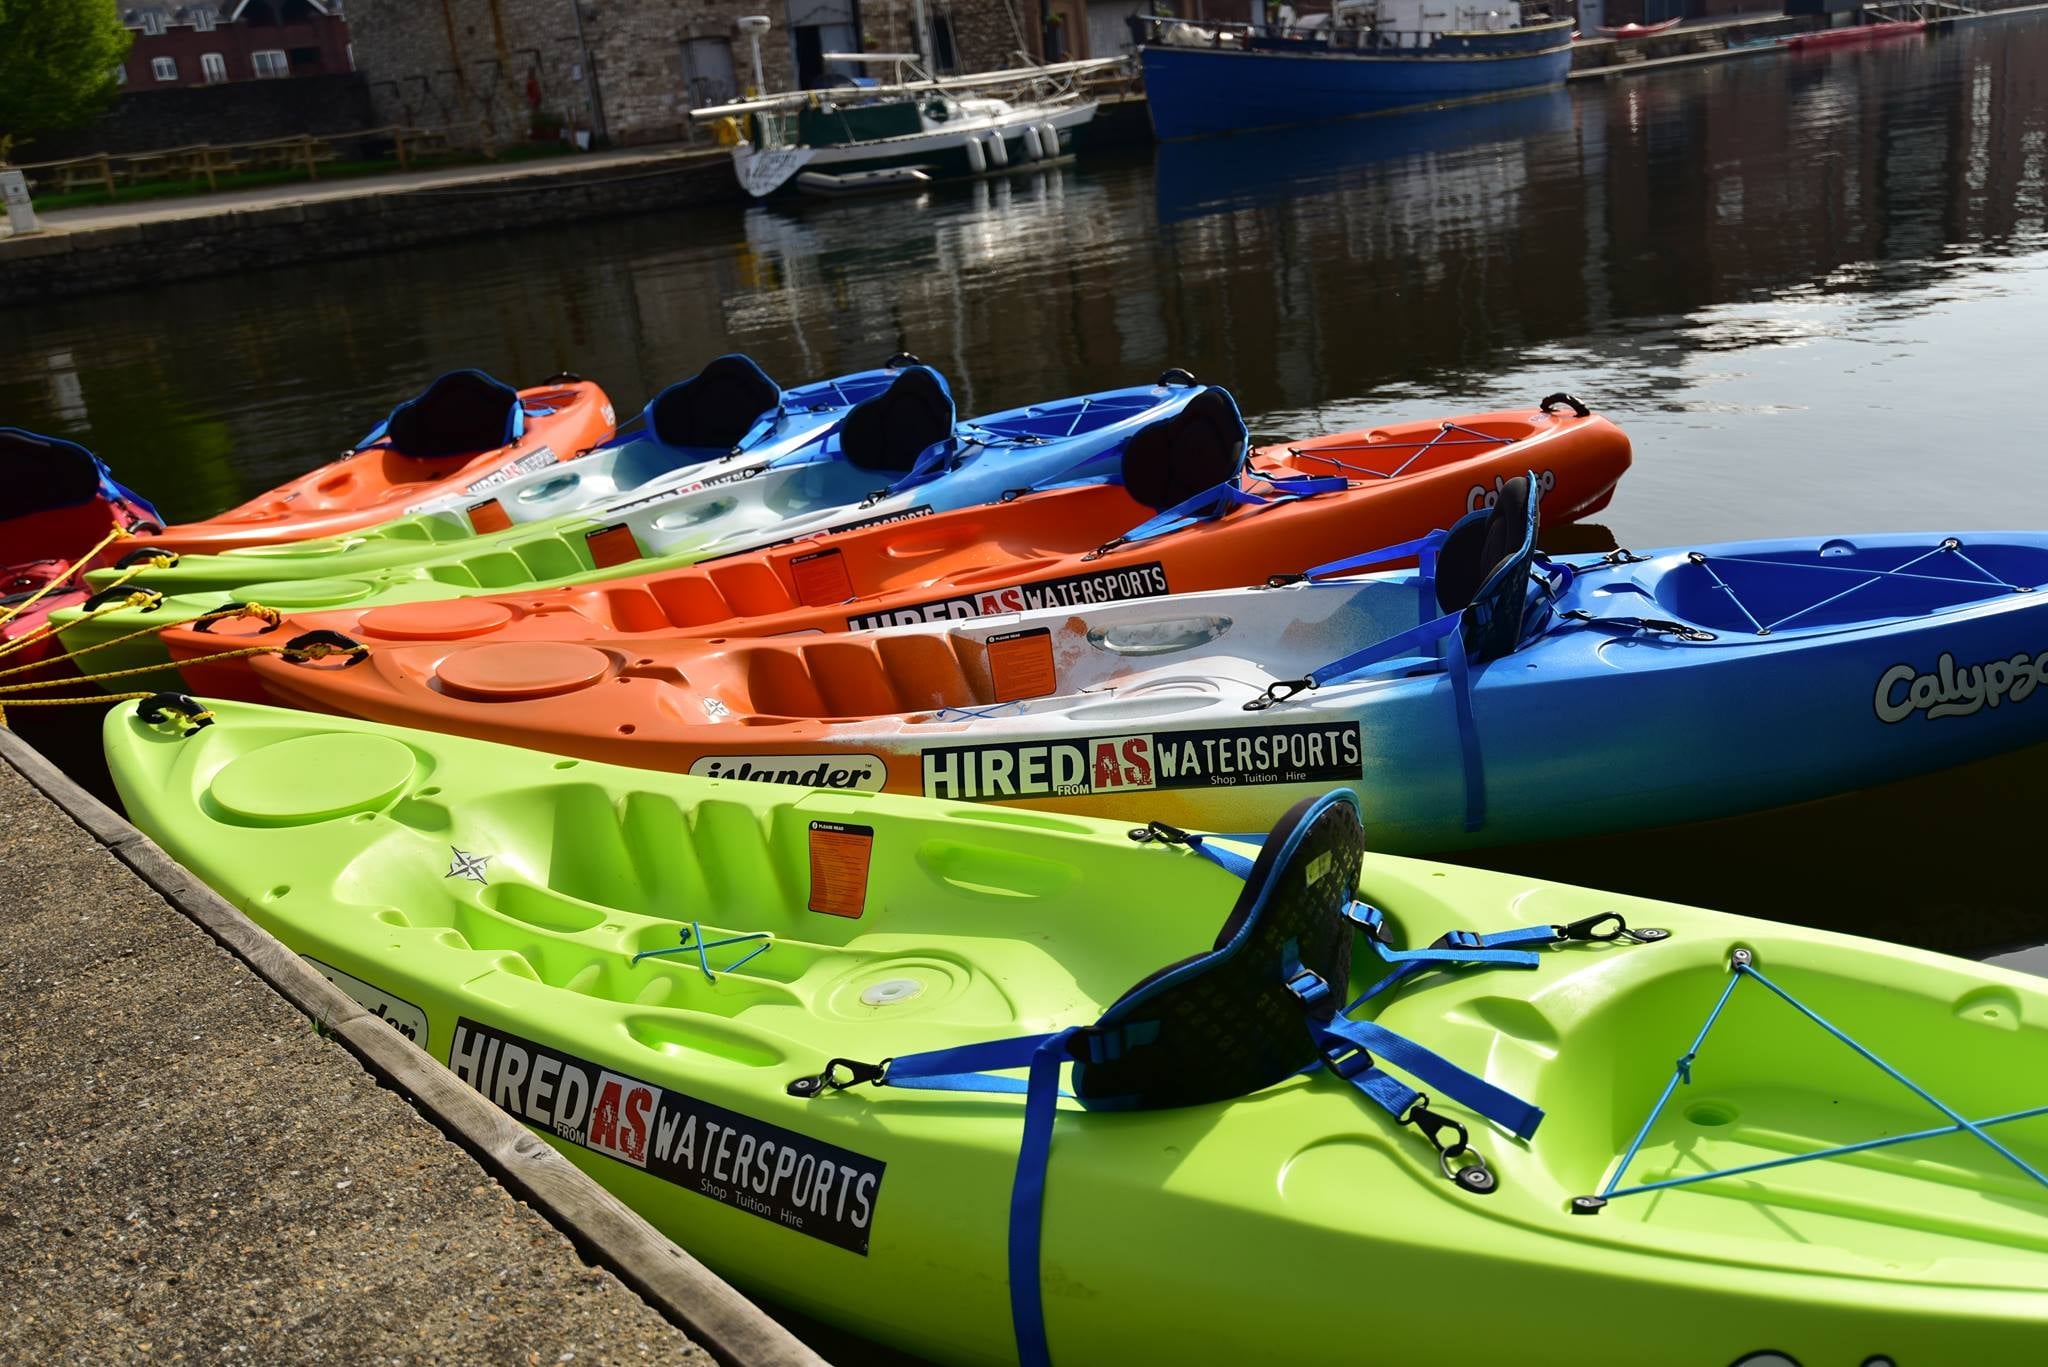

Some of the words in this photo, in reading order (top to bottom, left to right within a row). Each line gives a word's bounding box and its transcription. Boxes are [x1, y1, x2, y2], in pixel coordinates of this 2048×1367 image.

[1026, 566, 1166, 610] WATERSPORTS
[923, 745, 1085, 799] HIRED
[1057, 784, 1090, 796] FROM
[1093, 738, 1153, 788] AS
[1157, 729, 1359, 778] WATERSPORTS
[1211, 775, 1236, 786] Shop
[1243, 773, 1278, 784] Tuition
[1286, 771, 1307, 781] Hire
[450, 1026, 589, 1129] HIRED
[557, 1122, 586, 1145] FROM
[590, 1081, 652, 1163] AS
[655, 1105, 877, 1229] WATERSPORTS
[701, 1178, 728, 1200] Shop
[735, 1191, 771, 1217] Tuition
[780, 1208, 804, 1228] Hire
